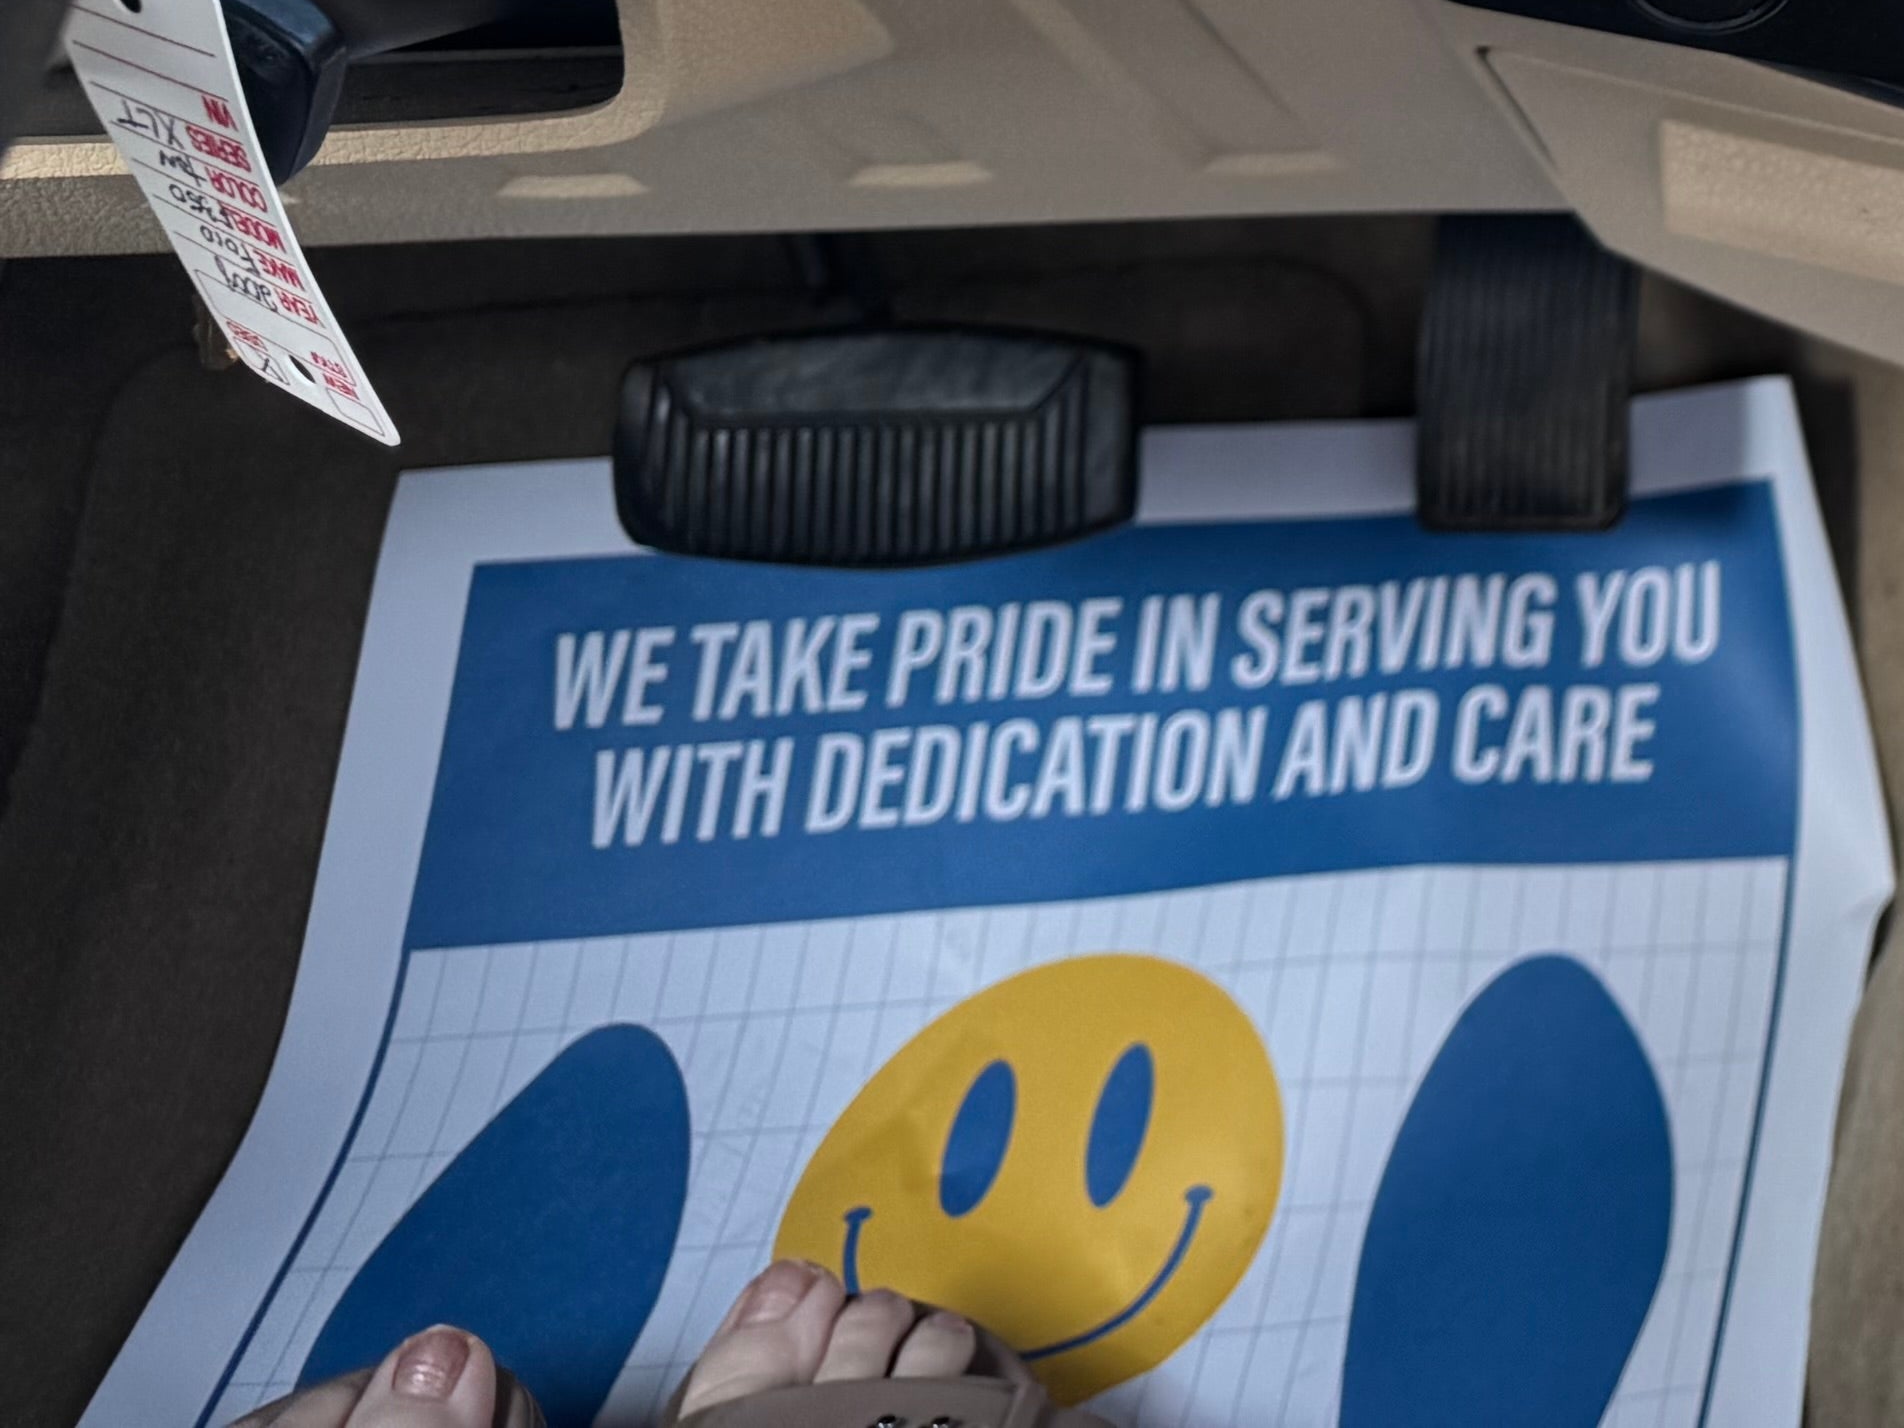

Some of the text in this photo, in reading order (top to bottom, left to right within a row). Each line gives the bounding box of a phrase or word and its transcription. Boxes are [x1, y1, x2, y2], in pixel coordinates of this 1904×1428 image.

[117, 99, 185, 151] XLT
[201, 95, 240, 133] VIN
[185, 125, 253, 173] SERIES
[205, 166, 268, 214] COLOR
[253, 249, 306, 293] MAKE
[274, 288, 327, 329] YEAR
[553, 561, 1722, 730] WE TAKE PRIDE IN SERVING YOU
[591, 683, 1661, 848] WITH DEDICATION AND CARE
